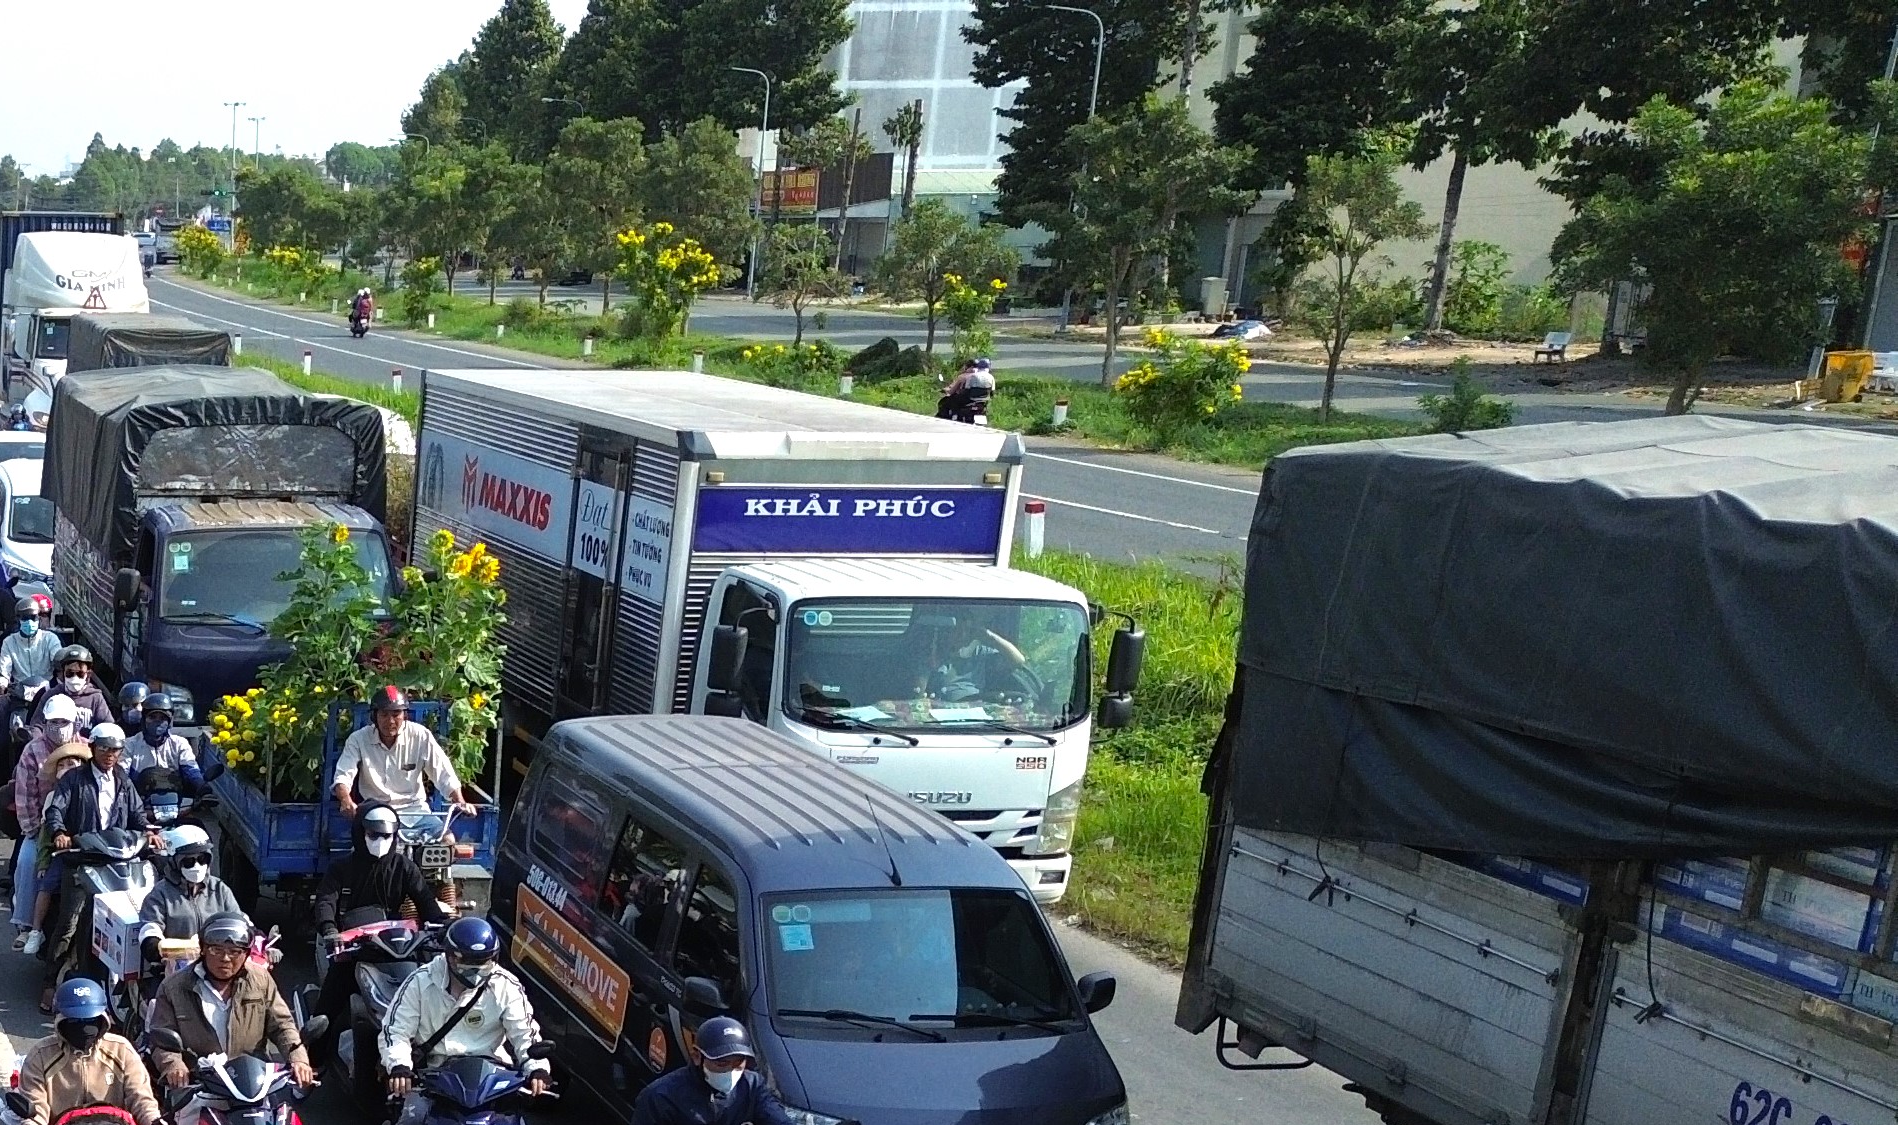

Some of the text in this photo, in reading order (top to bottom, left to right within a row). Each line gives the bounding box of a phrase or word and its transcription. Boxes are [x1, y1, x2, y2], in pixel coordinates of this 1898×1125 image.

[55, 274, 84, 292] GIA
[478, 472, 553, 532] MAXXIS
[743, 492, 956, 518] KHẢI PHÚC
[908, 790, 973, 804] ISUZU
